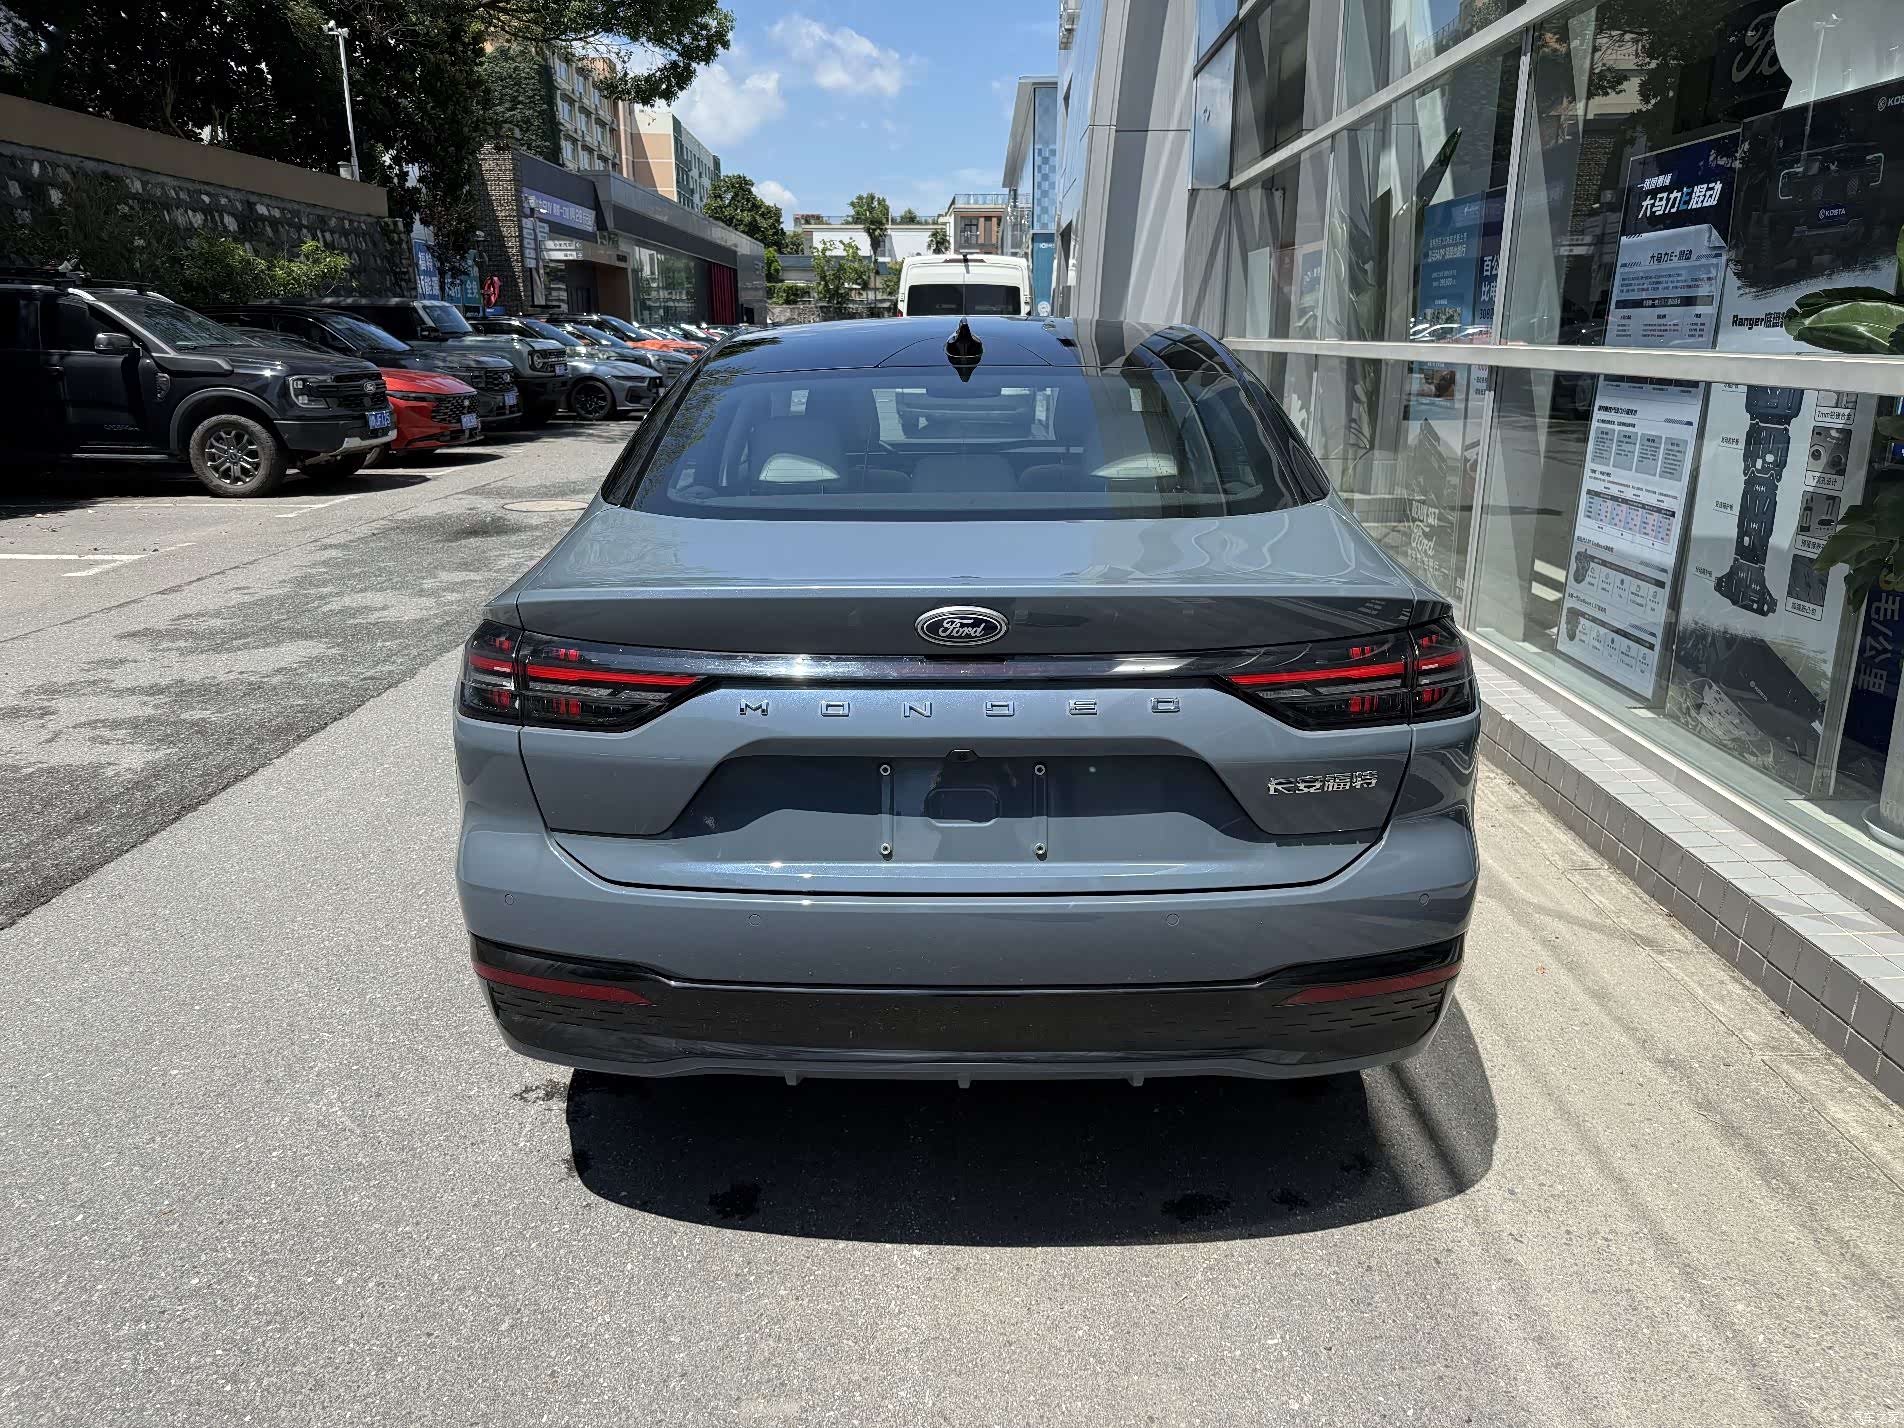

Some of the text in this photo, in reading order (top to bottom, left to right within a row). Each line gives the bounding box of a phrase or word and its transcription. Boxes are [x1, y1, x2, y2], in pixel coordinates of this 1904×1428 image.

[1638, 181, 1722, 218] 大马力E混动
[1825, 208, 1846, 217] KOSTA
[939, 619, 986, 637] Ford
[739, 696, 1181, 718] MONDEO
[1267, 770, 1378, 795] 长安福特
